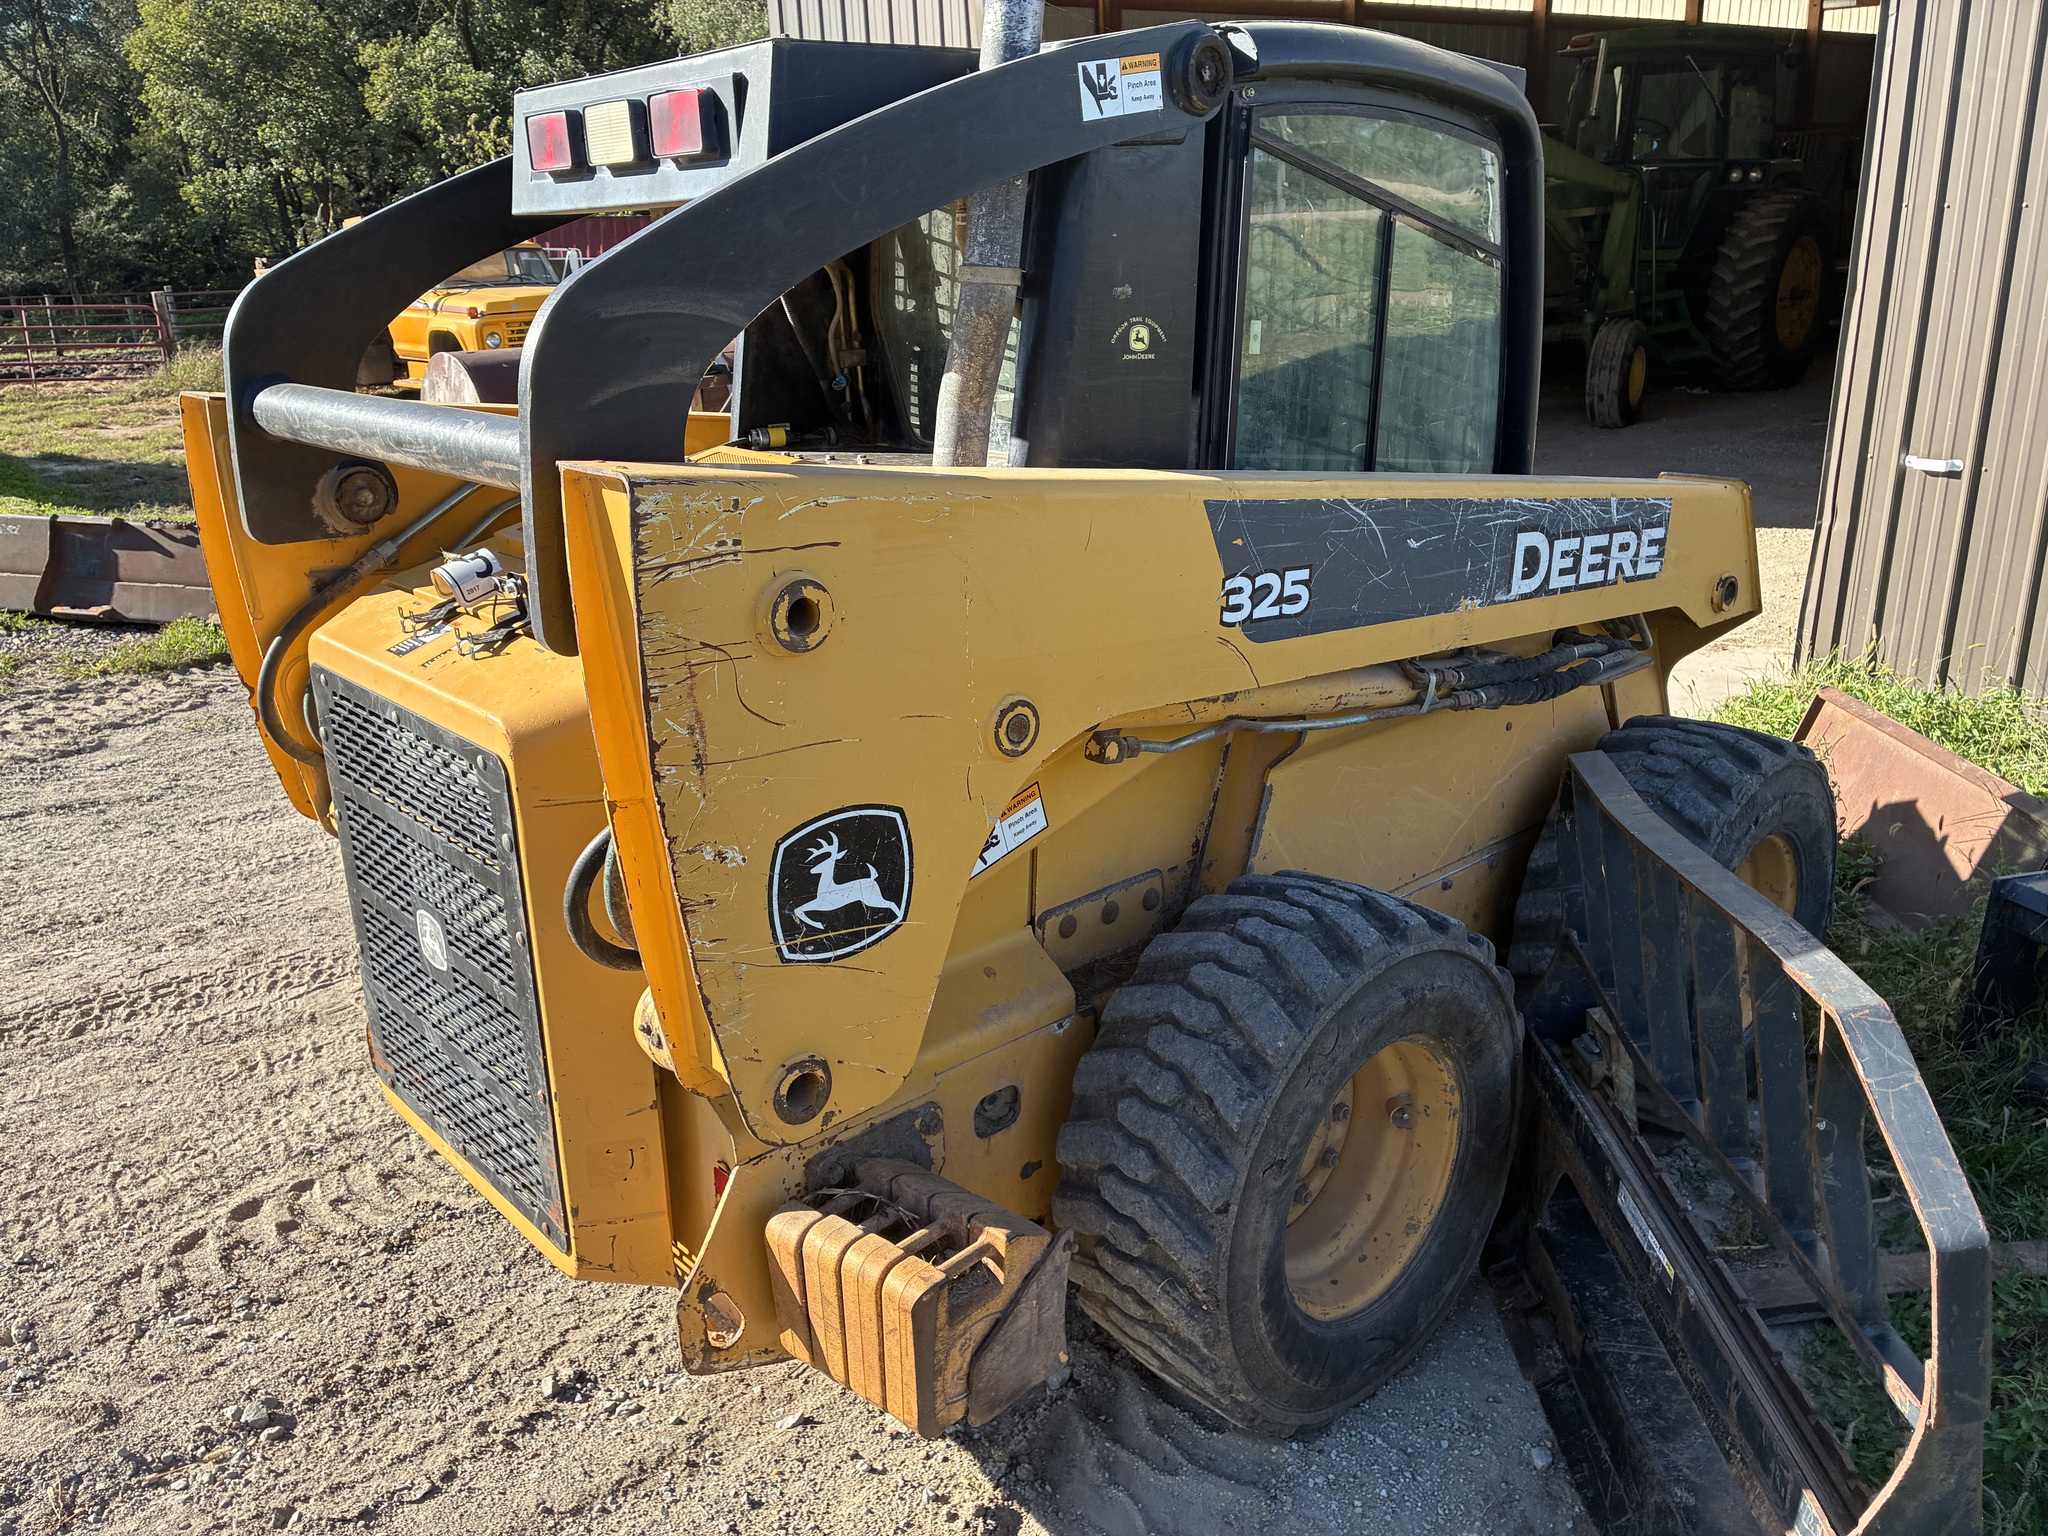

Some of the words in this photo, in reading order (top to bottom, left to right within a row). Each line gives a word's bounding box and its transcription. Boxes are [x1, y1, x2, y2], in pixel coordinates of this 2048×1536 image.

[1128, 58, 1157, 70] WARNING
[1127, 81, 1143, 90] Pinch
[1144, 79, 1157, 87] Area
[1143, 94, 1155, 102] Away
[1129, 316, 1143, 324] TRAIL
[1144, 317, 1168, 343] EQUIPMENT
[1510, 526, 1667, 596] DEERE
[466, 584, 481, 596] 2017
[1221, 568, 1310, 623] 325
[1006, 790, 1036, 813] WARNING
[1008, 815, 1025, 830] Pinch
[1024, 807, 1038, 819] Area
[1013, 827, 1026, 838] Keep
[1025, 820, 1038, 831] Away
